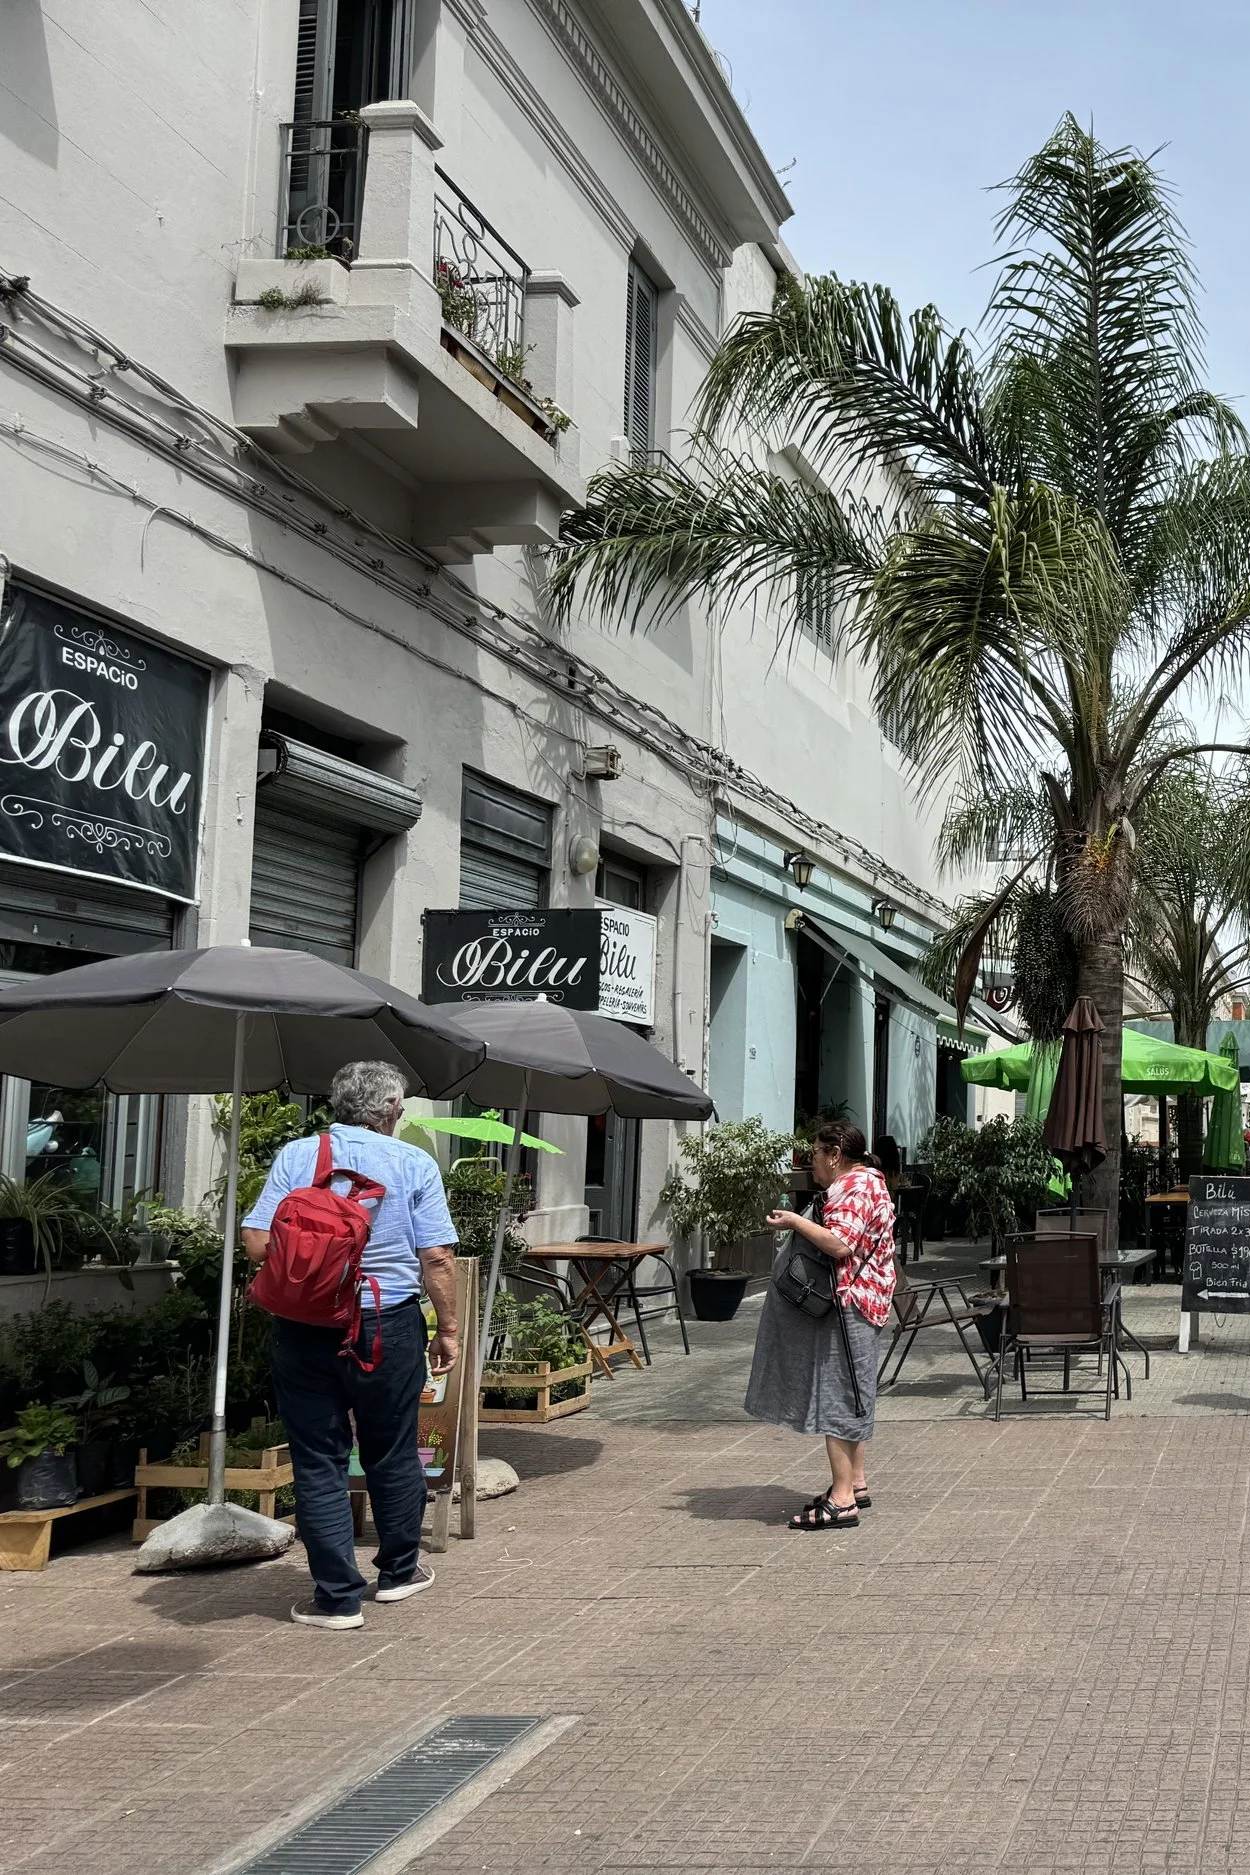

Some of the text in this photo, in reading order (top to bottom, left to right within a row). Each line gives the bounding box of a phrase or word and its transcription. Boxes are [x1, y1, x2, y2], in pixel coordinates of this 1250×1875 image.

[600, 916, 630, 937] SPACIO
[436, 935, 588, 987] Bilu
[1146, 1067, 1170, 1076] SALUS
